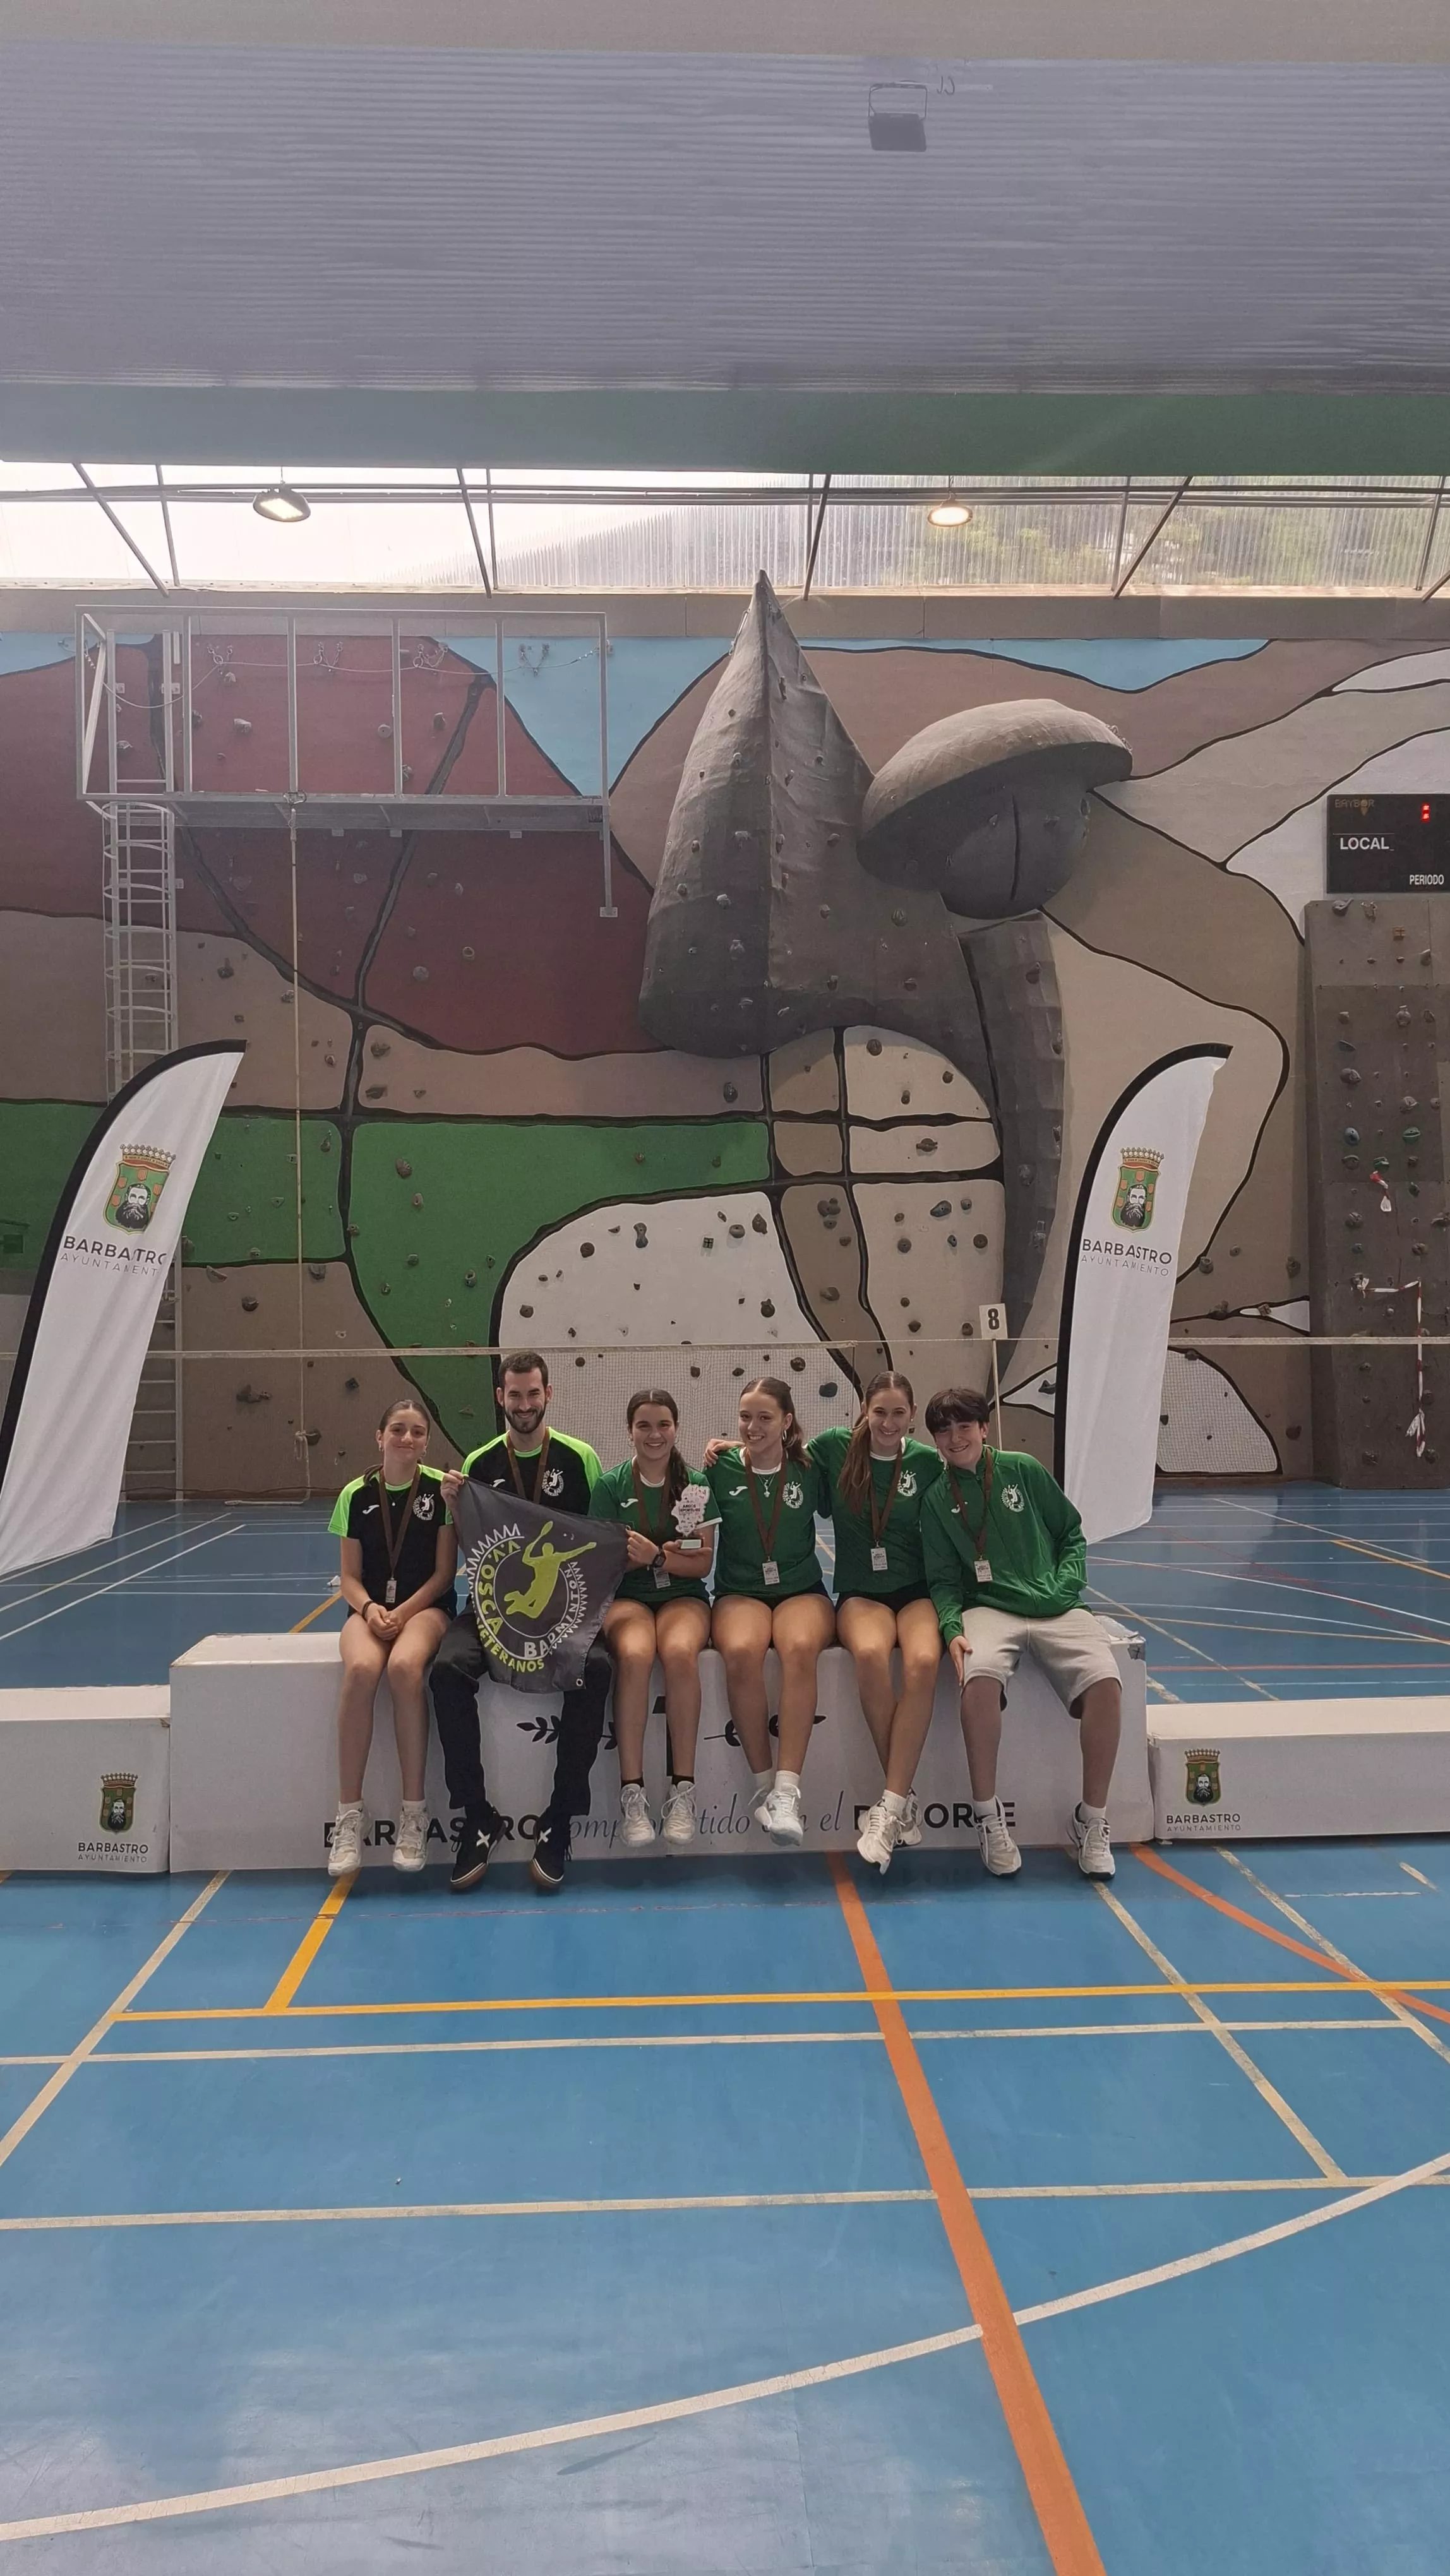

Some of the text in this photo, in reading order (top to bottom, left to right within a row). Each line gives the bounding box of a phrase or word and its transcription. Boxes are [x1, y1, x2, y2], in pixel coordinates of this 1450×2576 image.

[1339, 837, 1389, 850] LOCAL
[1409, 874, 1445, 885] PERIODO
[1082, 1239, 1172, 1265] BARBASTRO
[1081, 1255, 1169, 1277] AYUNTAMIENTO
[988, 1308, 1000, 1330] 8
[477, 1564, 504, 1635] OSCA
[524, 1569, 579, 1659] BADMINTON
[820, 1790, 844, 1832] el
[1166, 1813, 1241, 1824] BARBASTRO
[1166, 1824, 1242, 1832] AYUNTAMIENTO
[78, 1842, 149, 1854] BARBASTRO
[78, 1854, 148, 1863] AYUNTAMIENTO
